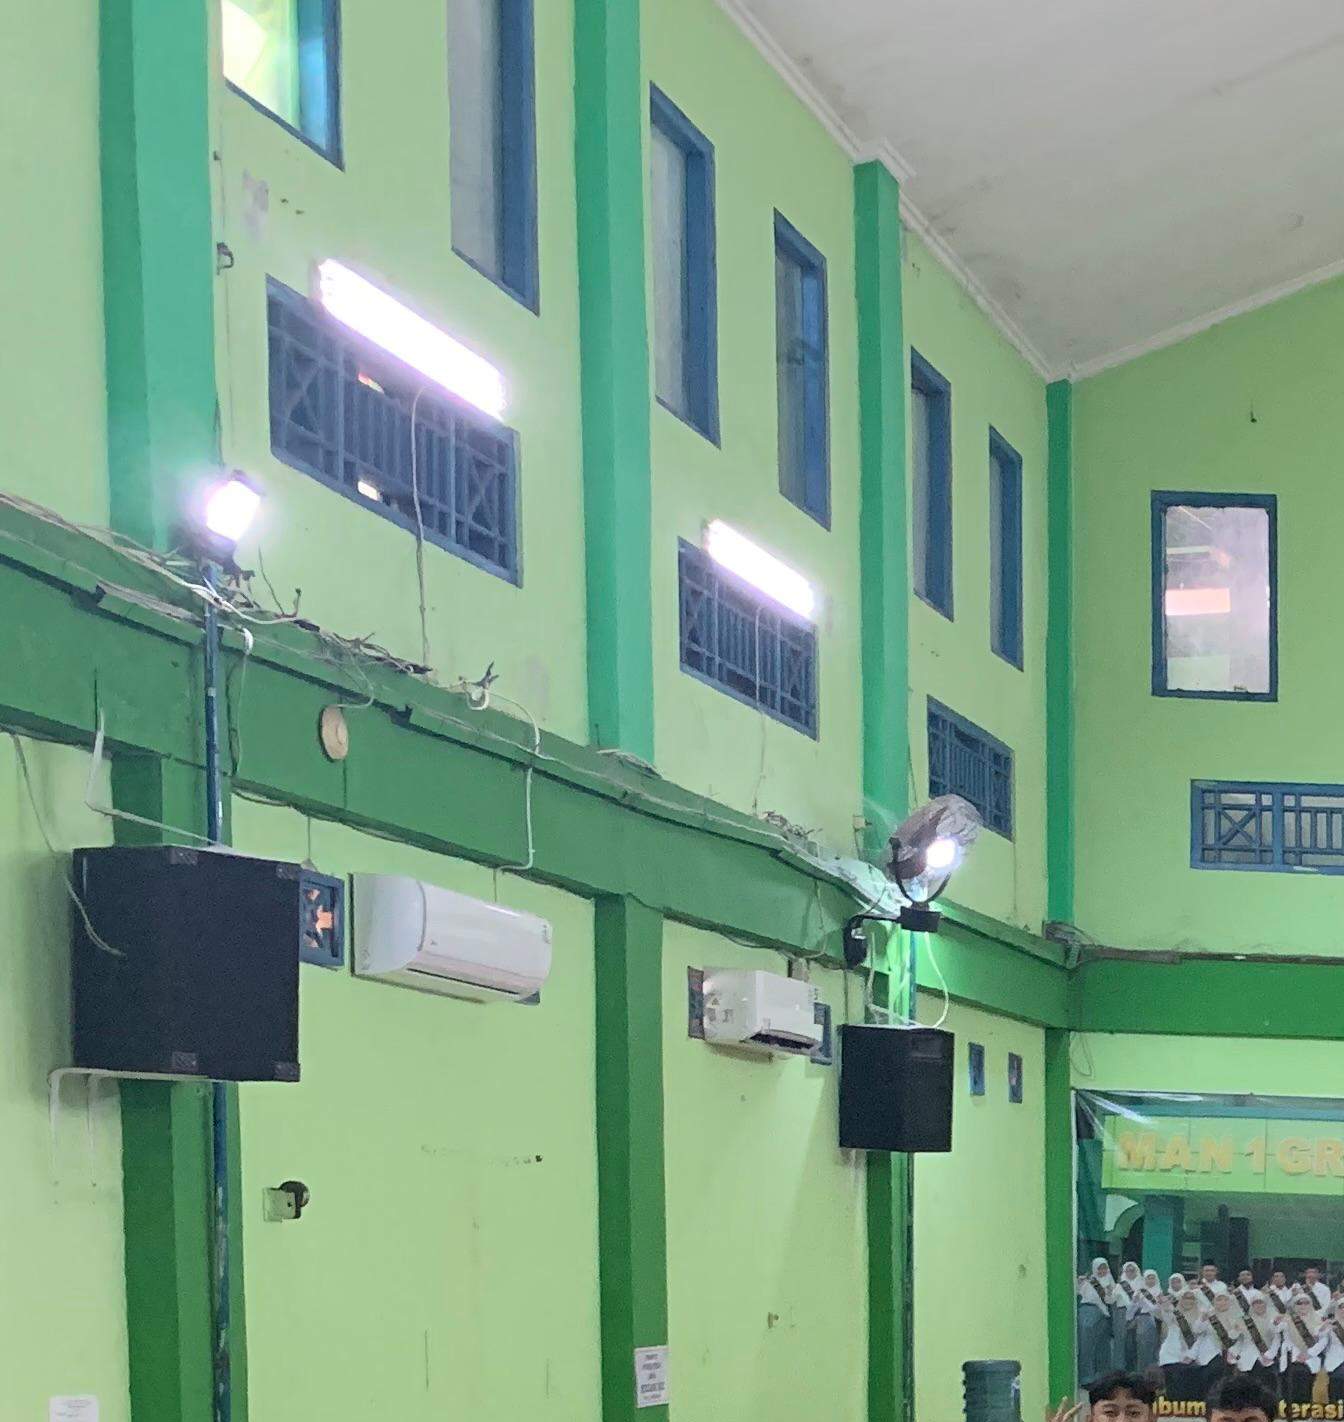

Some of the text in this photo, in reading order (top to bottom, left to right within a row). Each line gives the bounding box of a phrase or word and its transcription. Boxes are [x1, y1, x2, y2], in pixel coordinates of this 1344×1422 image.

[1117, 1130, 1234, 1174] MAN
[1245, 1136, 1267, 1175] 1
[1278, 1400, 1344, 1420] terasi
